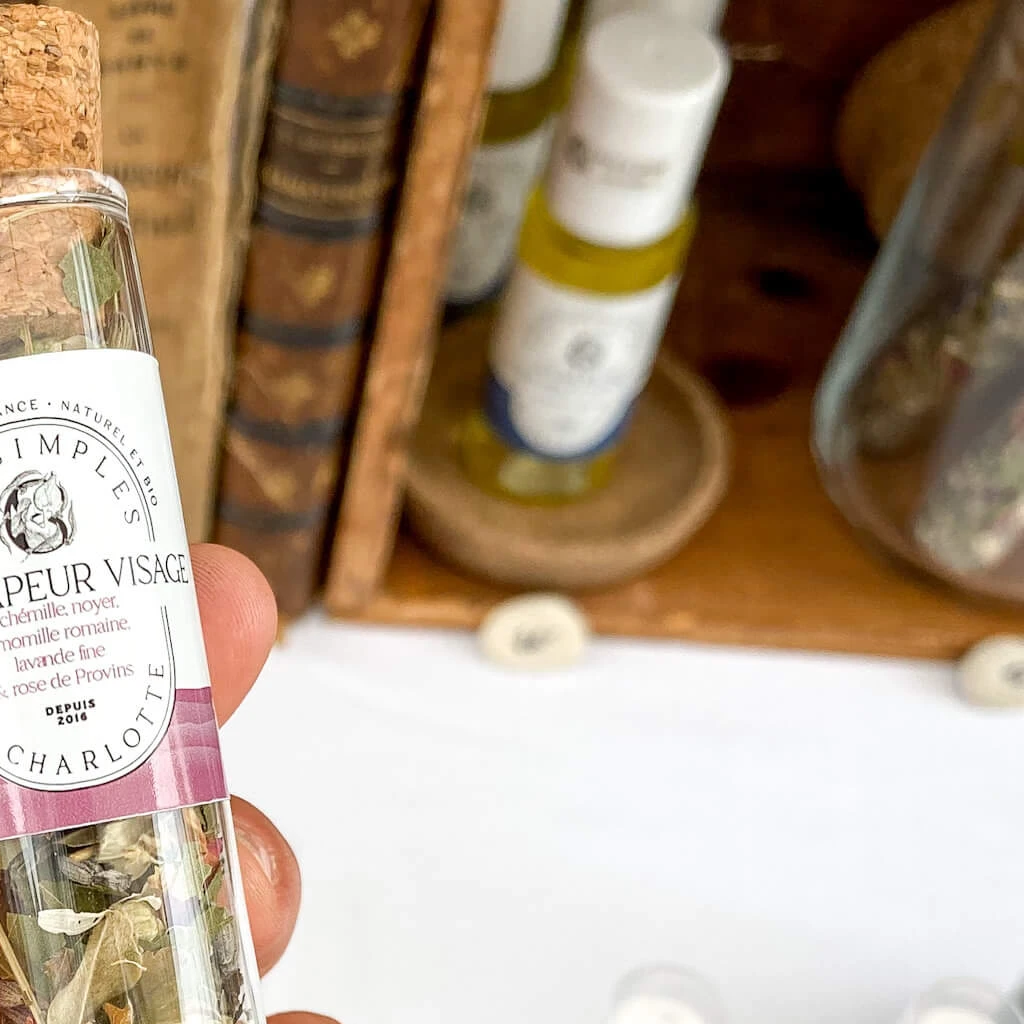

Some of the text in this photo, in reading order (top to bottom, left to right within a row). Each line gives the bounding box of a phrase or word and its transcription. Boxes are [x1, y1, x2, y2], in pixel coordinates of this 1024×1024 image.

[60, 400, 126, 446] NATUREL
[129, 448, 144, 468] ET
[143, 476, 158, 507] BIO
[104, 554, 189, 587] VISAGE
[14, 643, 106, 673] lavande fine
[12, 677, 47, 698] rose
[50, 672, 72, 690] de
[75, 662, 136, 686] Provins
[7, 663, 164, 776] CHARLOTTE
[45, 698, 96, 717] DEPUIS
[56, 711, 88, 726] 2016
